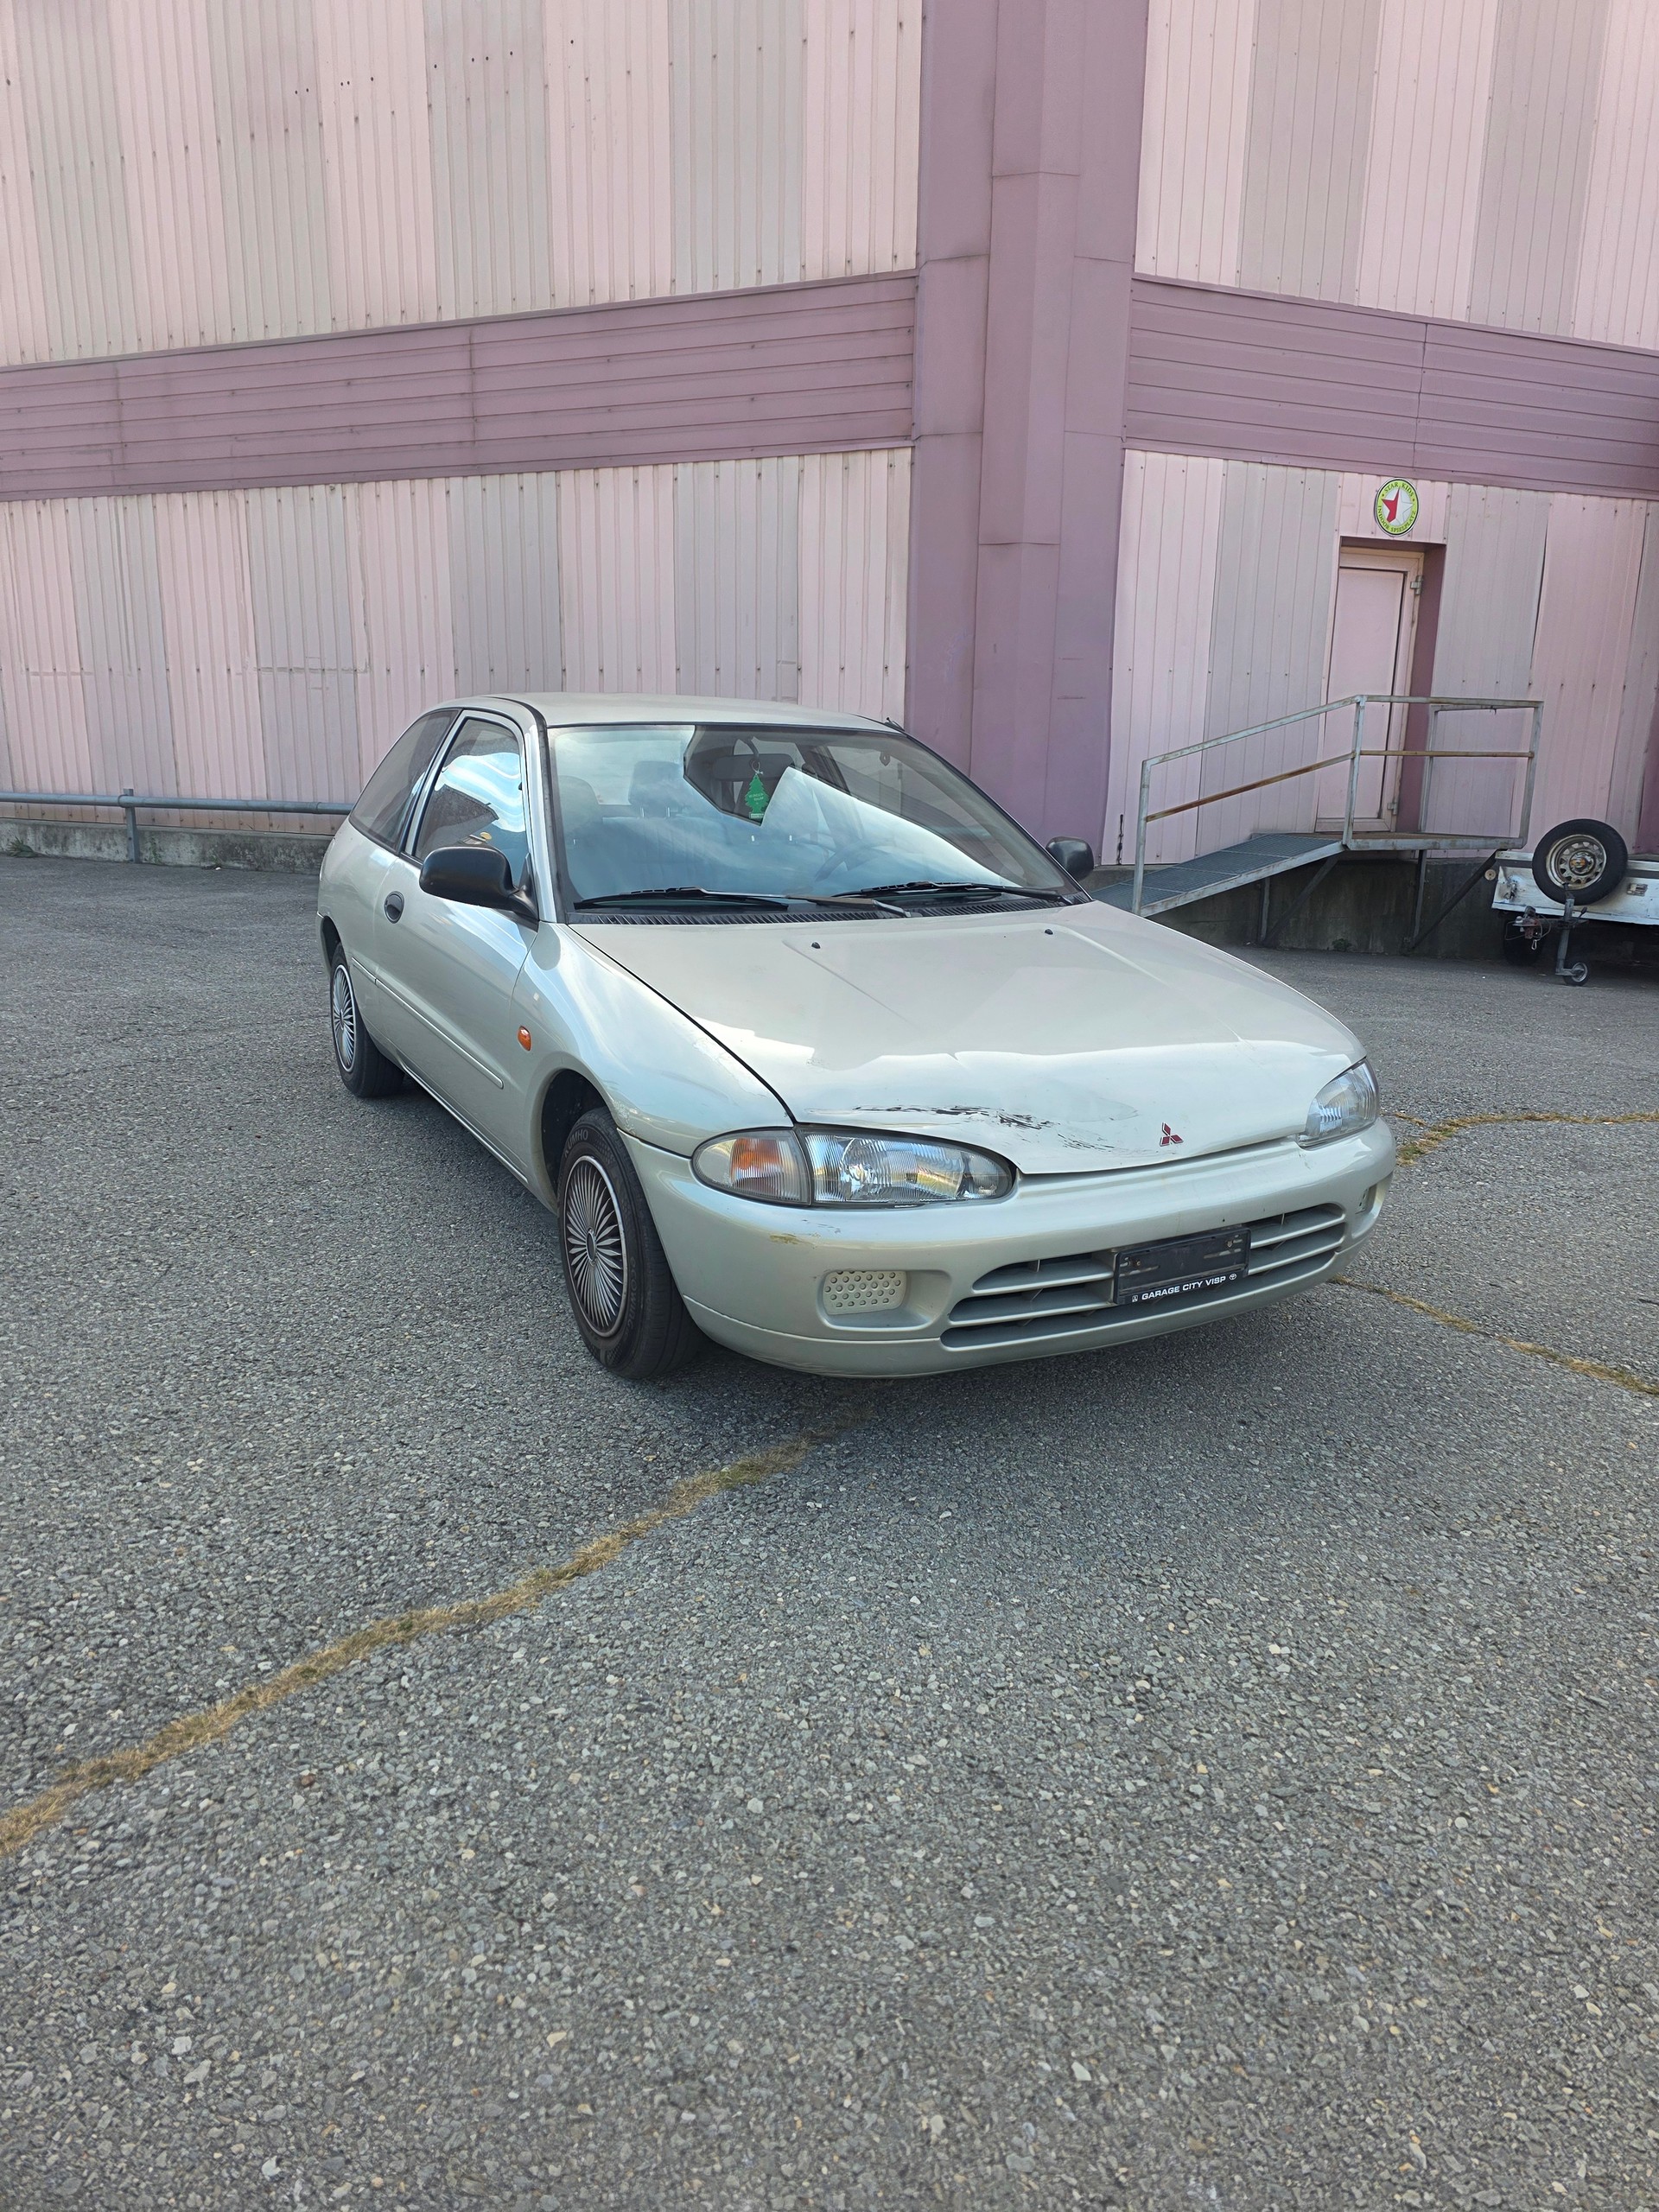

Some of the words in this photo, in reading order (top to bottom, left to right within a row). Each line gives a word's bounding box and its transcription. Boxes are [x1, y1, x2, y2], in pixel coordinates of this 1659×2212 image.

[1384, 482, 1398, 493] STAR
[1402, 483, 1414, 497] KIDS
[1378, 505, 1391, 531] INDOOR
[1391, 511, 1416, 532] SPIELPLATZ
[564, 1128, 588, 1158] KUMHO
[1141, 1286, 1180, 1300] GARAGE
[1183, 1281, 1203, 1291] CITY
[1205, 1275, 1226, 1287] VISP
